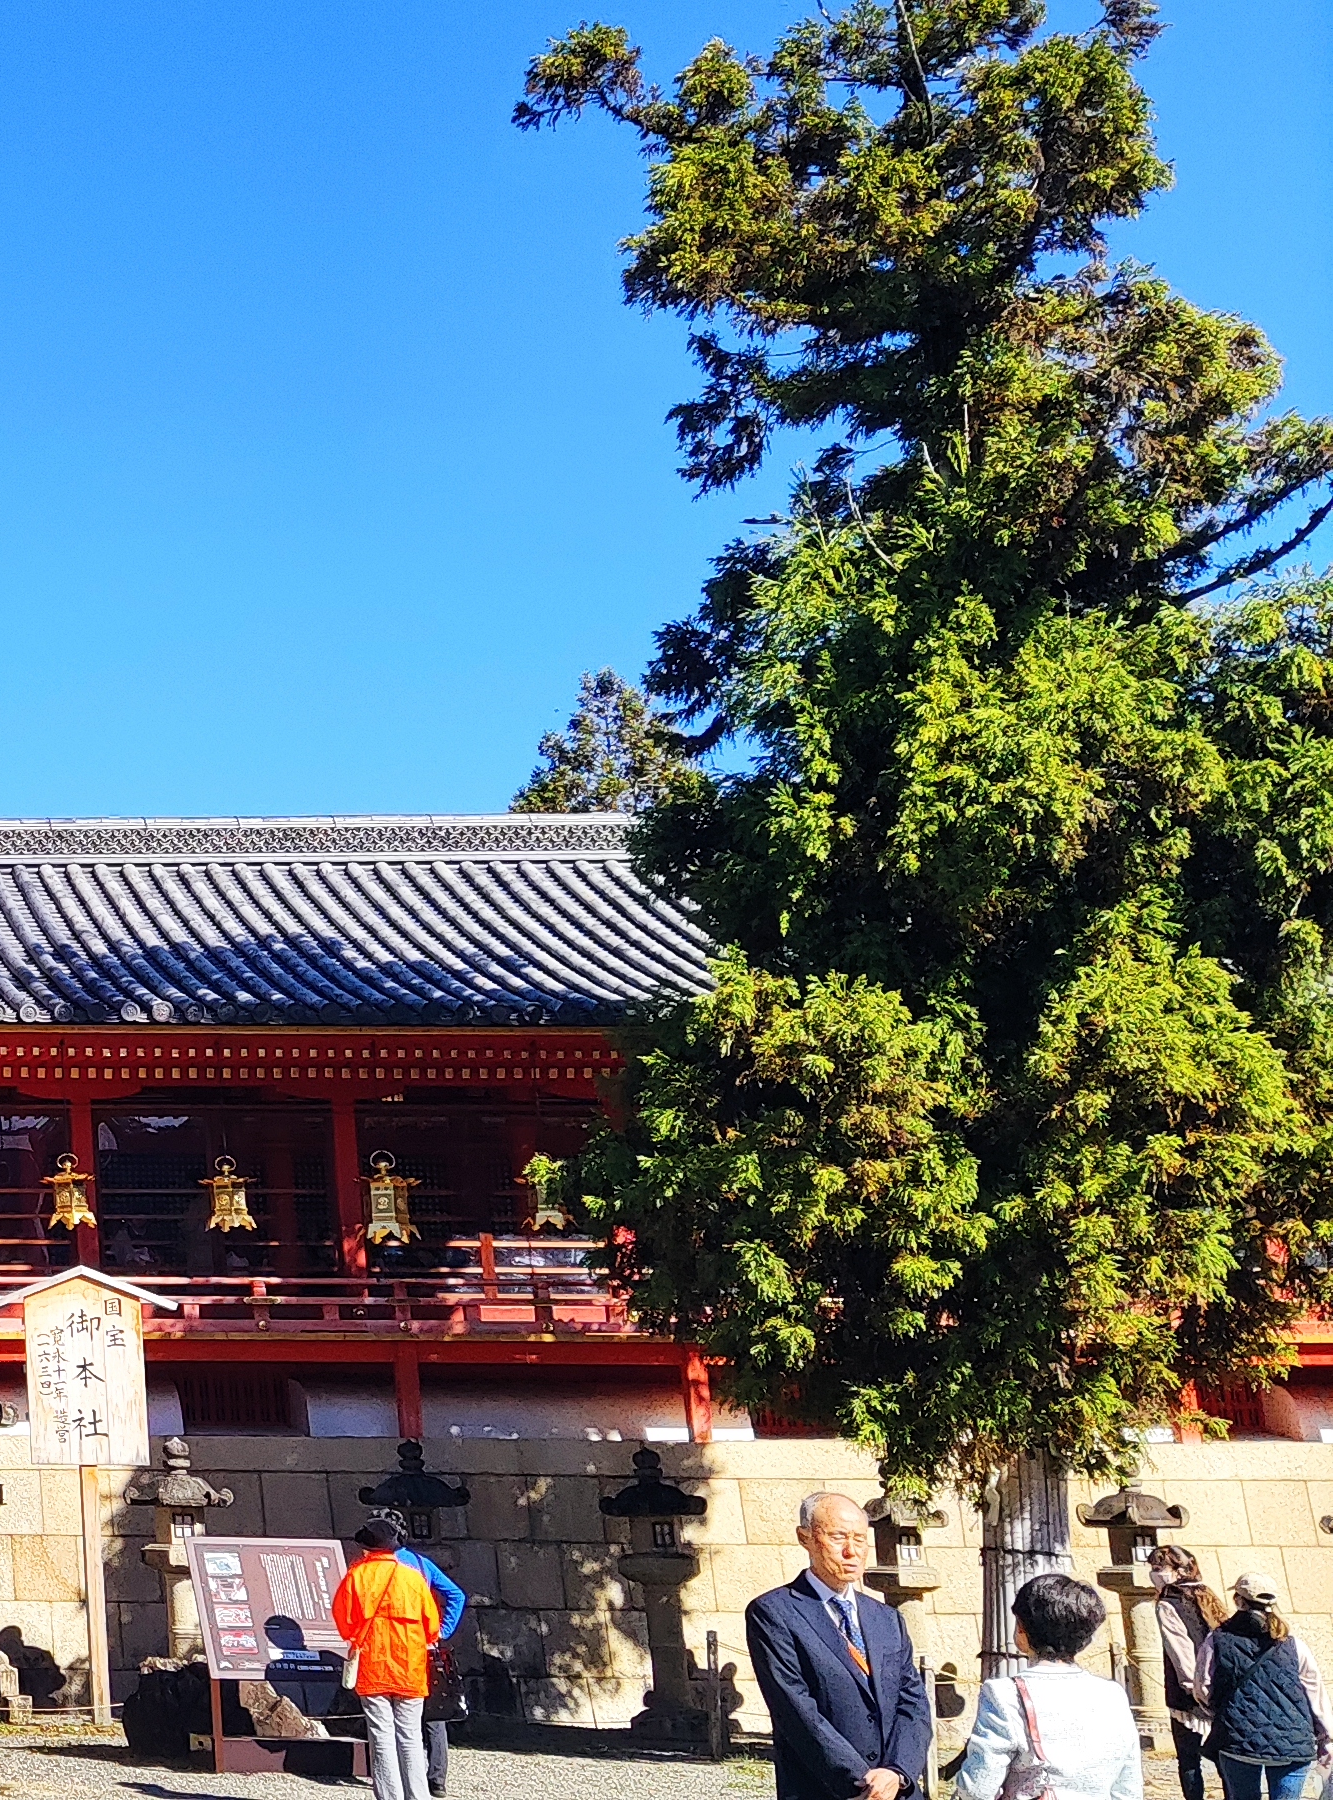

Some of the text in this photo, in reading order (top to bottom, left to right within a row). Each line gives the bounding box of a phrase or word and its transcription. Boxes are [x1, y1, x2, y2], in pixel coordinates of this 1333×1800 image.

[104, 1298, 126, 1347] 国宝
[50, 1326, 69, 1402] 寛永十一年
[66, 1309, 109, 1440] 御本社
